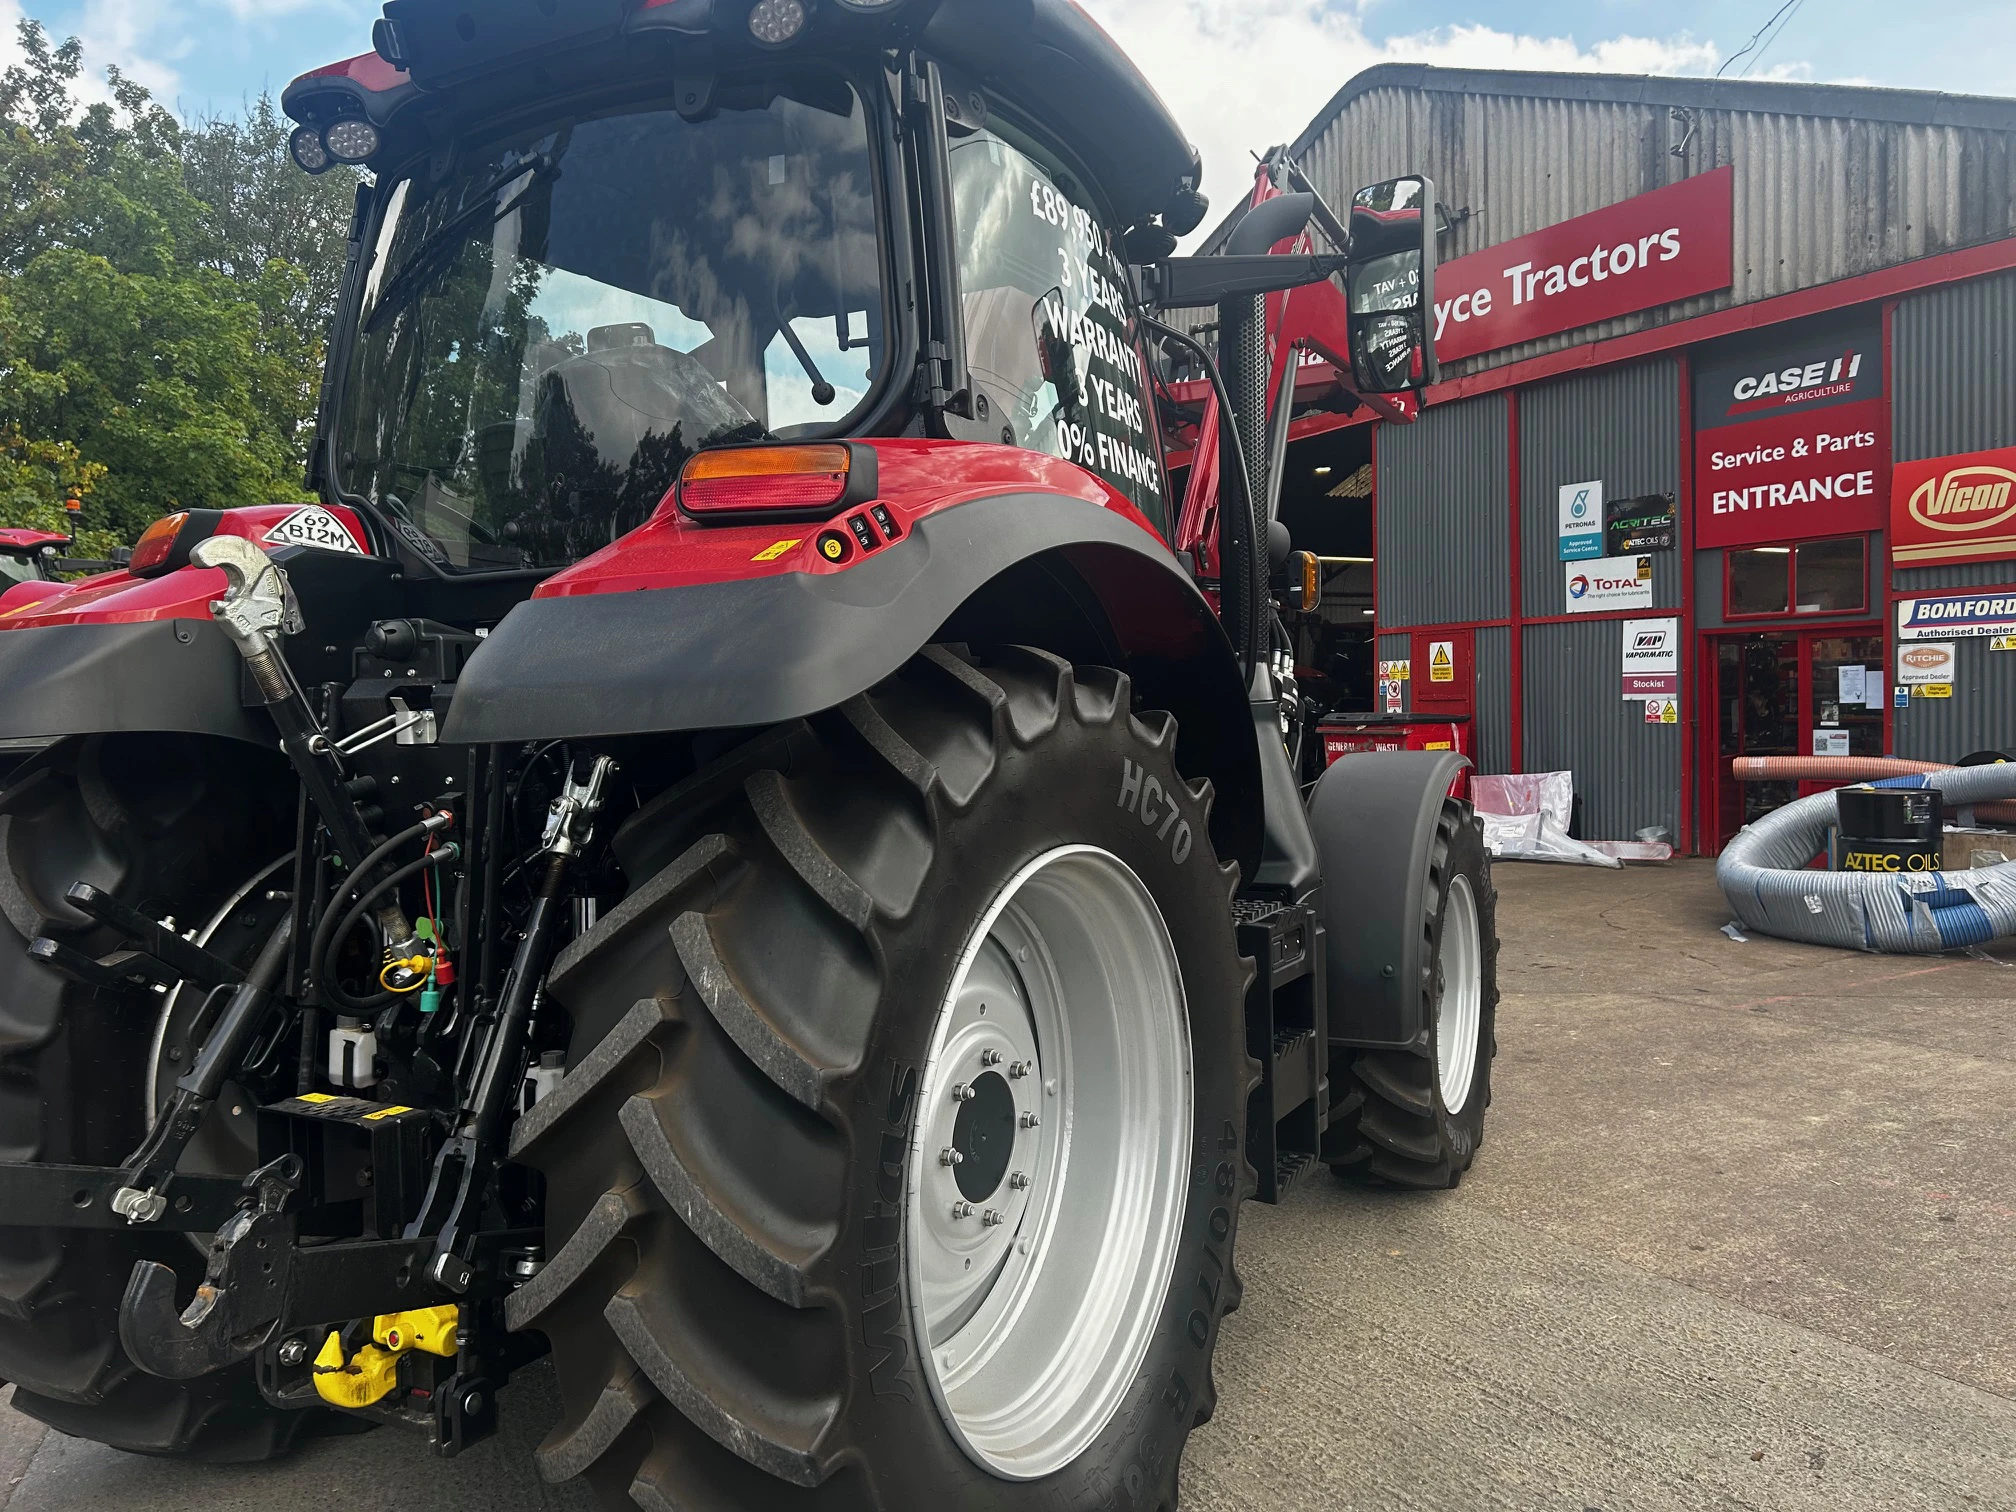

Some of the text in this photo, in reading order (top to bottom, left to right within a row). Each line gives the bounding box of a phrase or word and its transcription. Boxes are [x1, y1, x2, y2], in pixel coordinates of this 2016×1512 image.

[1503, 227, 1680, 306] Tractors
[1057, 247, 1128, 328] 3 YEARS
[1042, 295, 1143, 388] WARRANTY
[1733, 361, 1826, 401] CASE
[1074, 367, 1143, 434] 3 YEARS
[1785, 382, 1851, 404] AGRICULTURE
[1057, 419, 1160, 496] 0% FINANCE
[1711, 429, 1875, 471] Service & Parts
[1713, 470, 1873, 515] ENTRANCE
[1926, 476, 2012, 516] Vicon
[304, 514, 330, 528] 69
[1565, 520, 1596, 529] PETRONAS
[1610, 514, 1672, 530] AGRITEC
[1563, 546, 1581, 554] Service
[1568, 539, 1593, 547] Approved
[1593, 579, 1643, 591] TOTAL
[1916, 599, 2016, 620] BOMFORD
[1636, 635, 1663, 647] VAP
[1916, 625, 2015, 638] Authorised Dealer
[1625, 650, 1673, 659] VAPORMATIC
[1905, 653, 1945, 663] RITCHIE
[1632, 679, 1665, 688] Stockist
[1901, 672, 1950, 681] Approved Dealer
[1117, 756, 1192, 865] HC70
[1845, 852, 1940, 872] AZTEC OILS
[1186, 1119, 1238, 1350] 480/70
